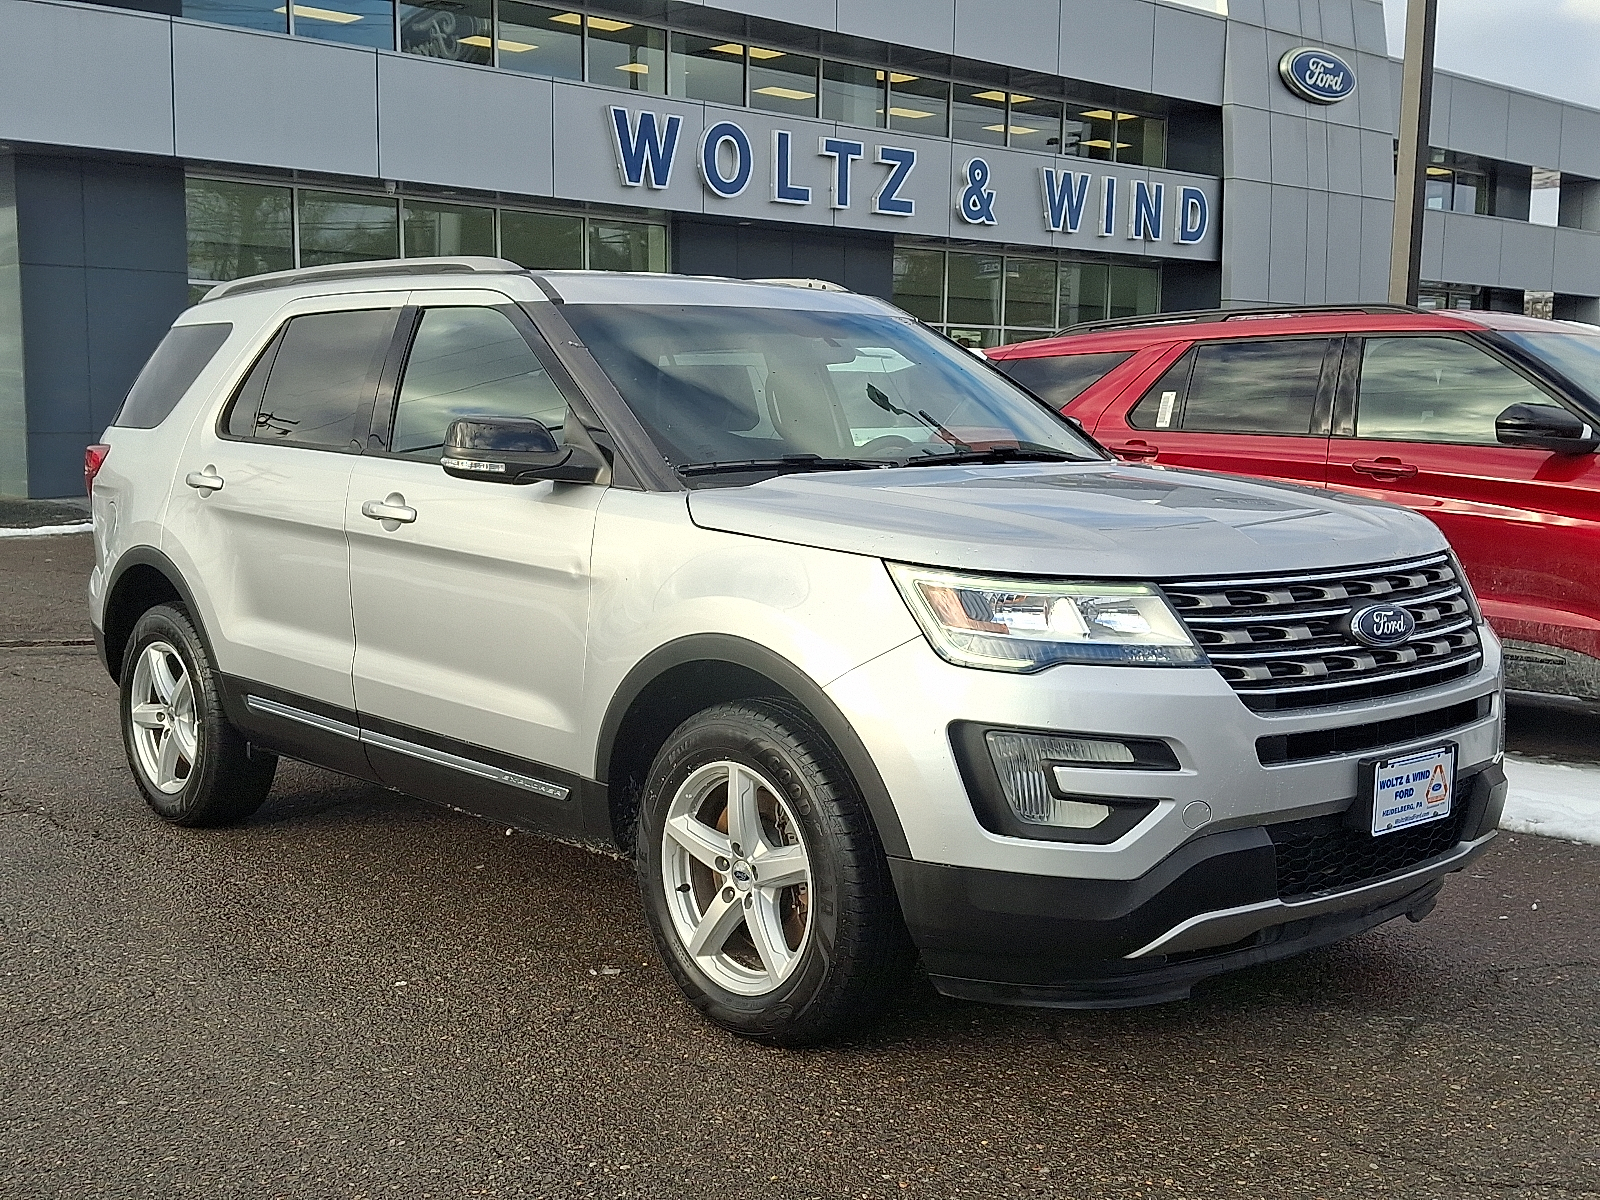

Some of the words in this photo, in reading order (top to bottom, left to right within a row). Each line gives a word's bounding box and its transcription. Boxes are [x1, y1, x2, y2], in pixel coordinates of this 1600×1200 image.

[1305, 57, 1345, 91] Ford
[605, 104, 917, 217] WOLTZ
[955, 156, 998, 226] &
[1039, 166, 1209, 245] WIND
[1373, 611, 1407, 636] Ford
[1379, 776, 1403, 790] WOLTZ
[1405, 774, 1410, 784] &
[1412, 770, 1430, 782] WIND
[1394, 787, 1414, 801] FORD
[1416, 801, 1423, 809] PA
